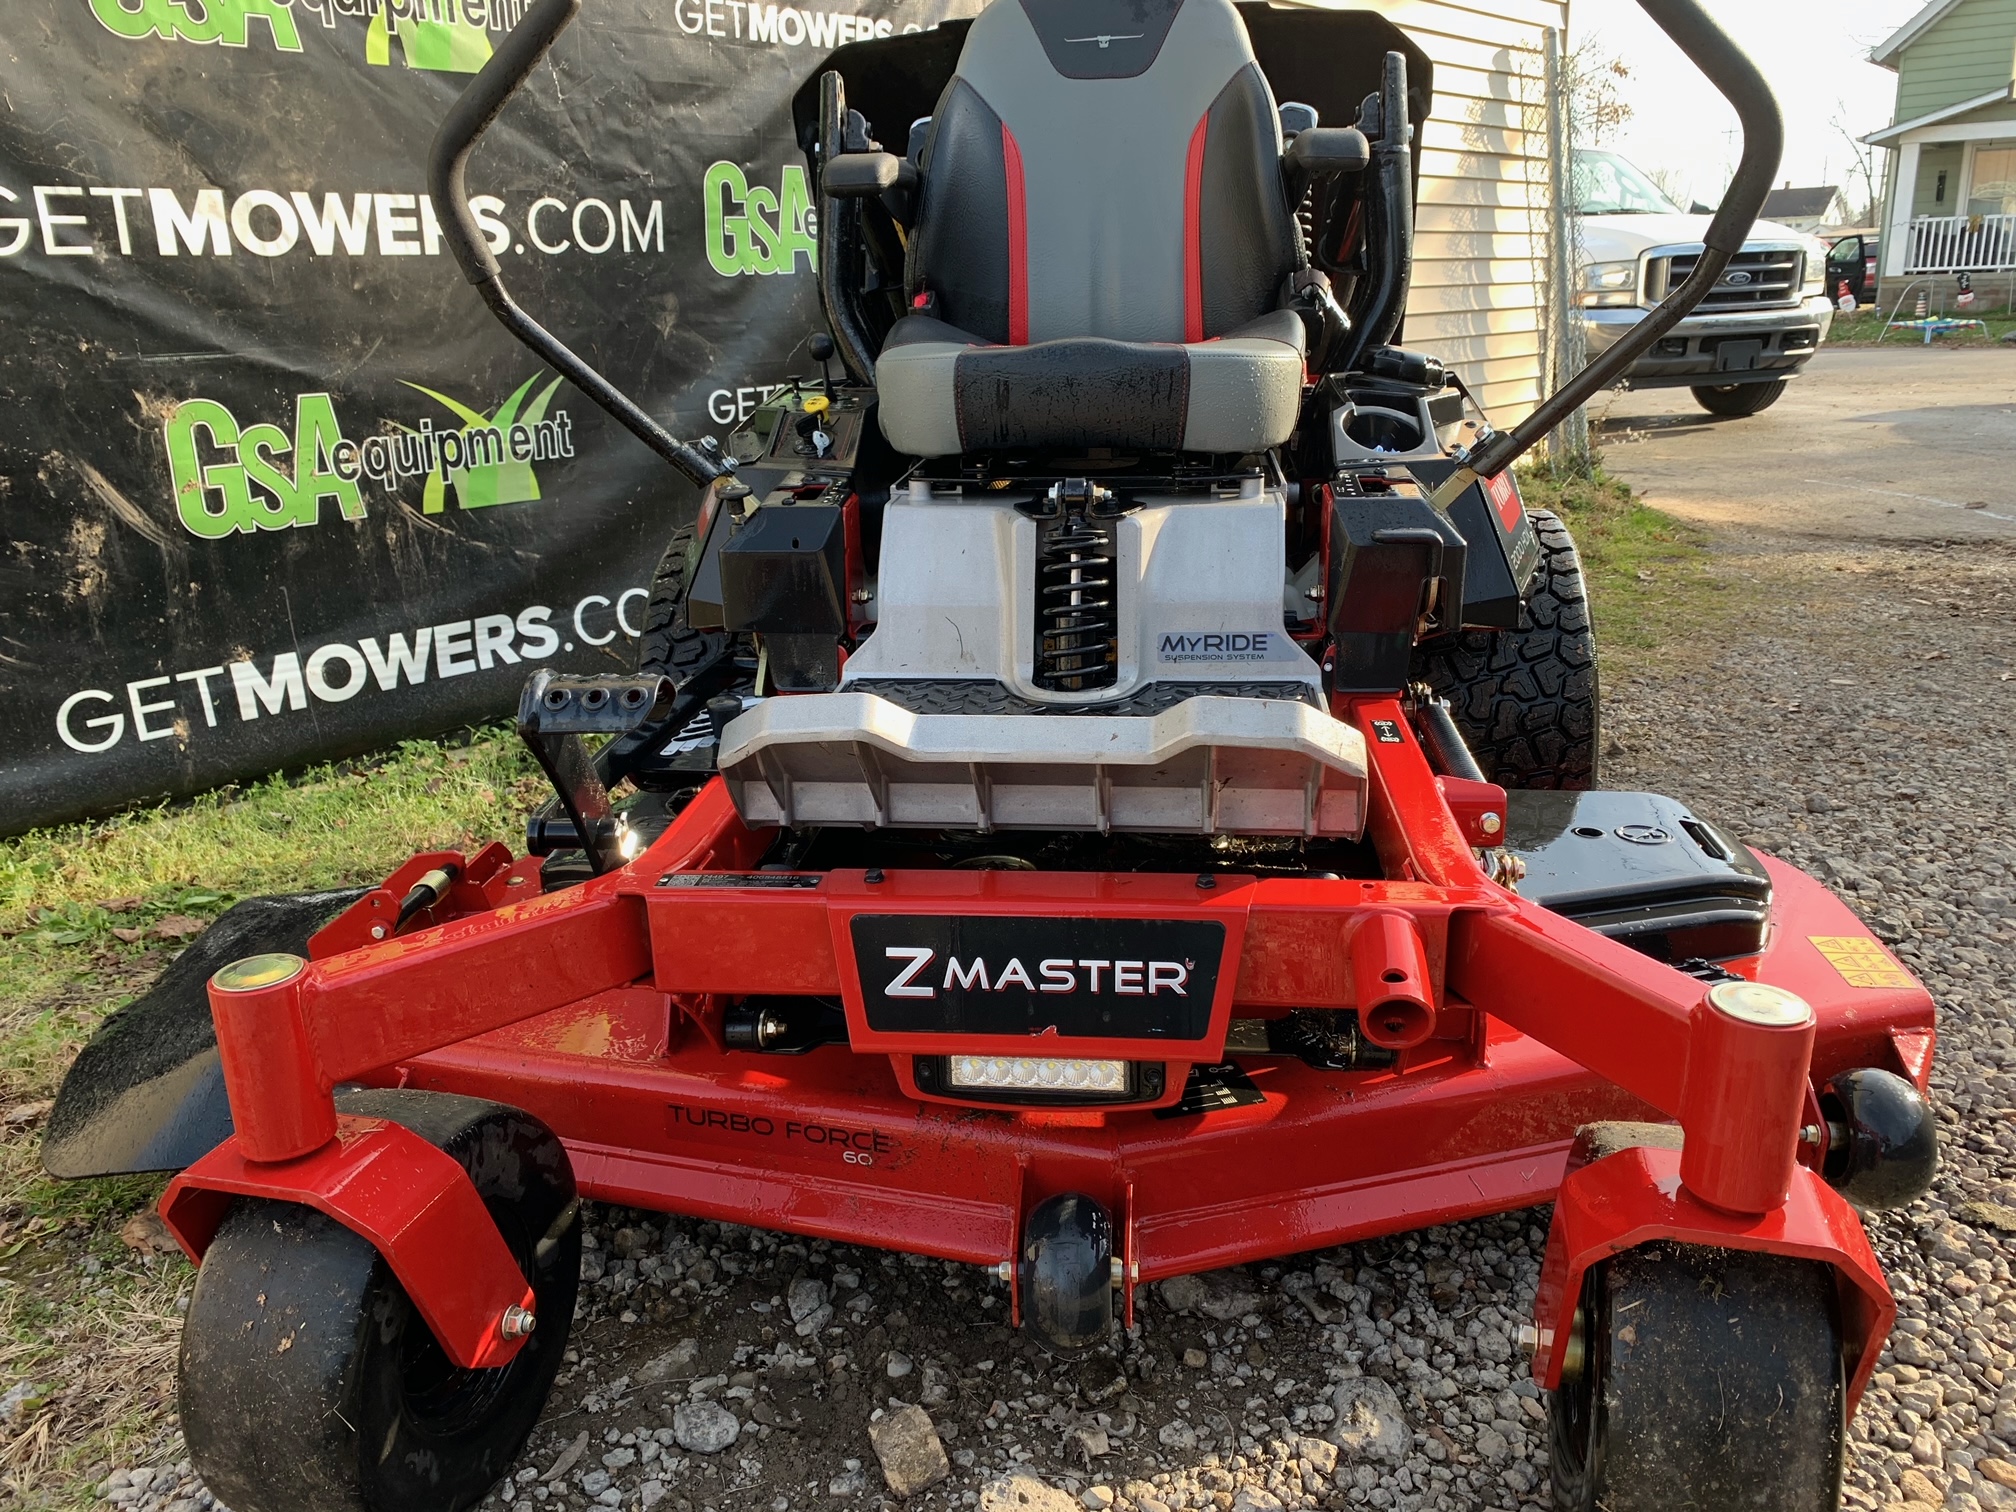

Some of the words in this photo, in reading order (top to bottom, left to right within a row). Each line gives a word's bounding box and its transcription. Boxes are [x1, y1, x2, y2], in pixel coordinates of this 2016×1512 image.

[330, 410, 575, 491] equipment
[1164, 653, 1224, 661] SUSPENSION
[884, 946, 936, 999] Z
[942, 956, 1188, 997] MASTER
[668, 1104, 775, 1136] TURBO
[785, 1121, 891, 1153] FORCE
[842, 1150, 873, 1167] 60
